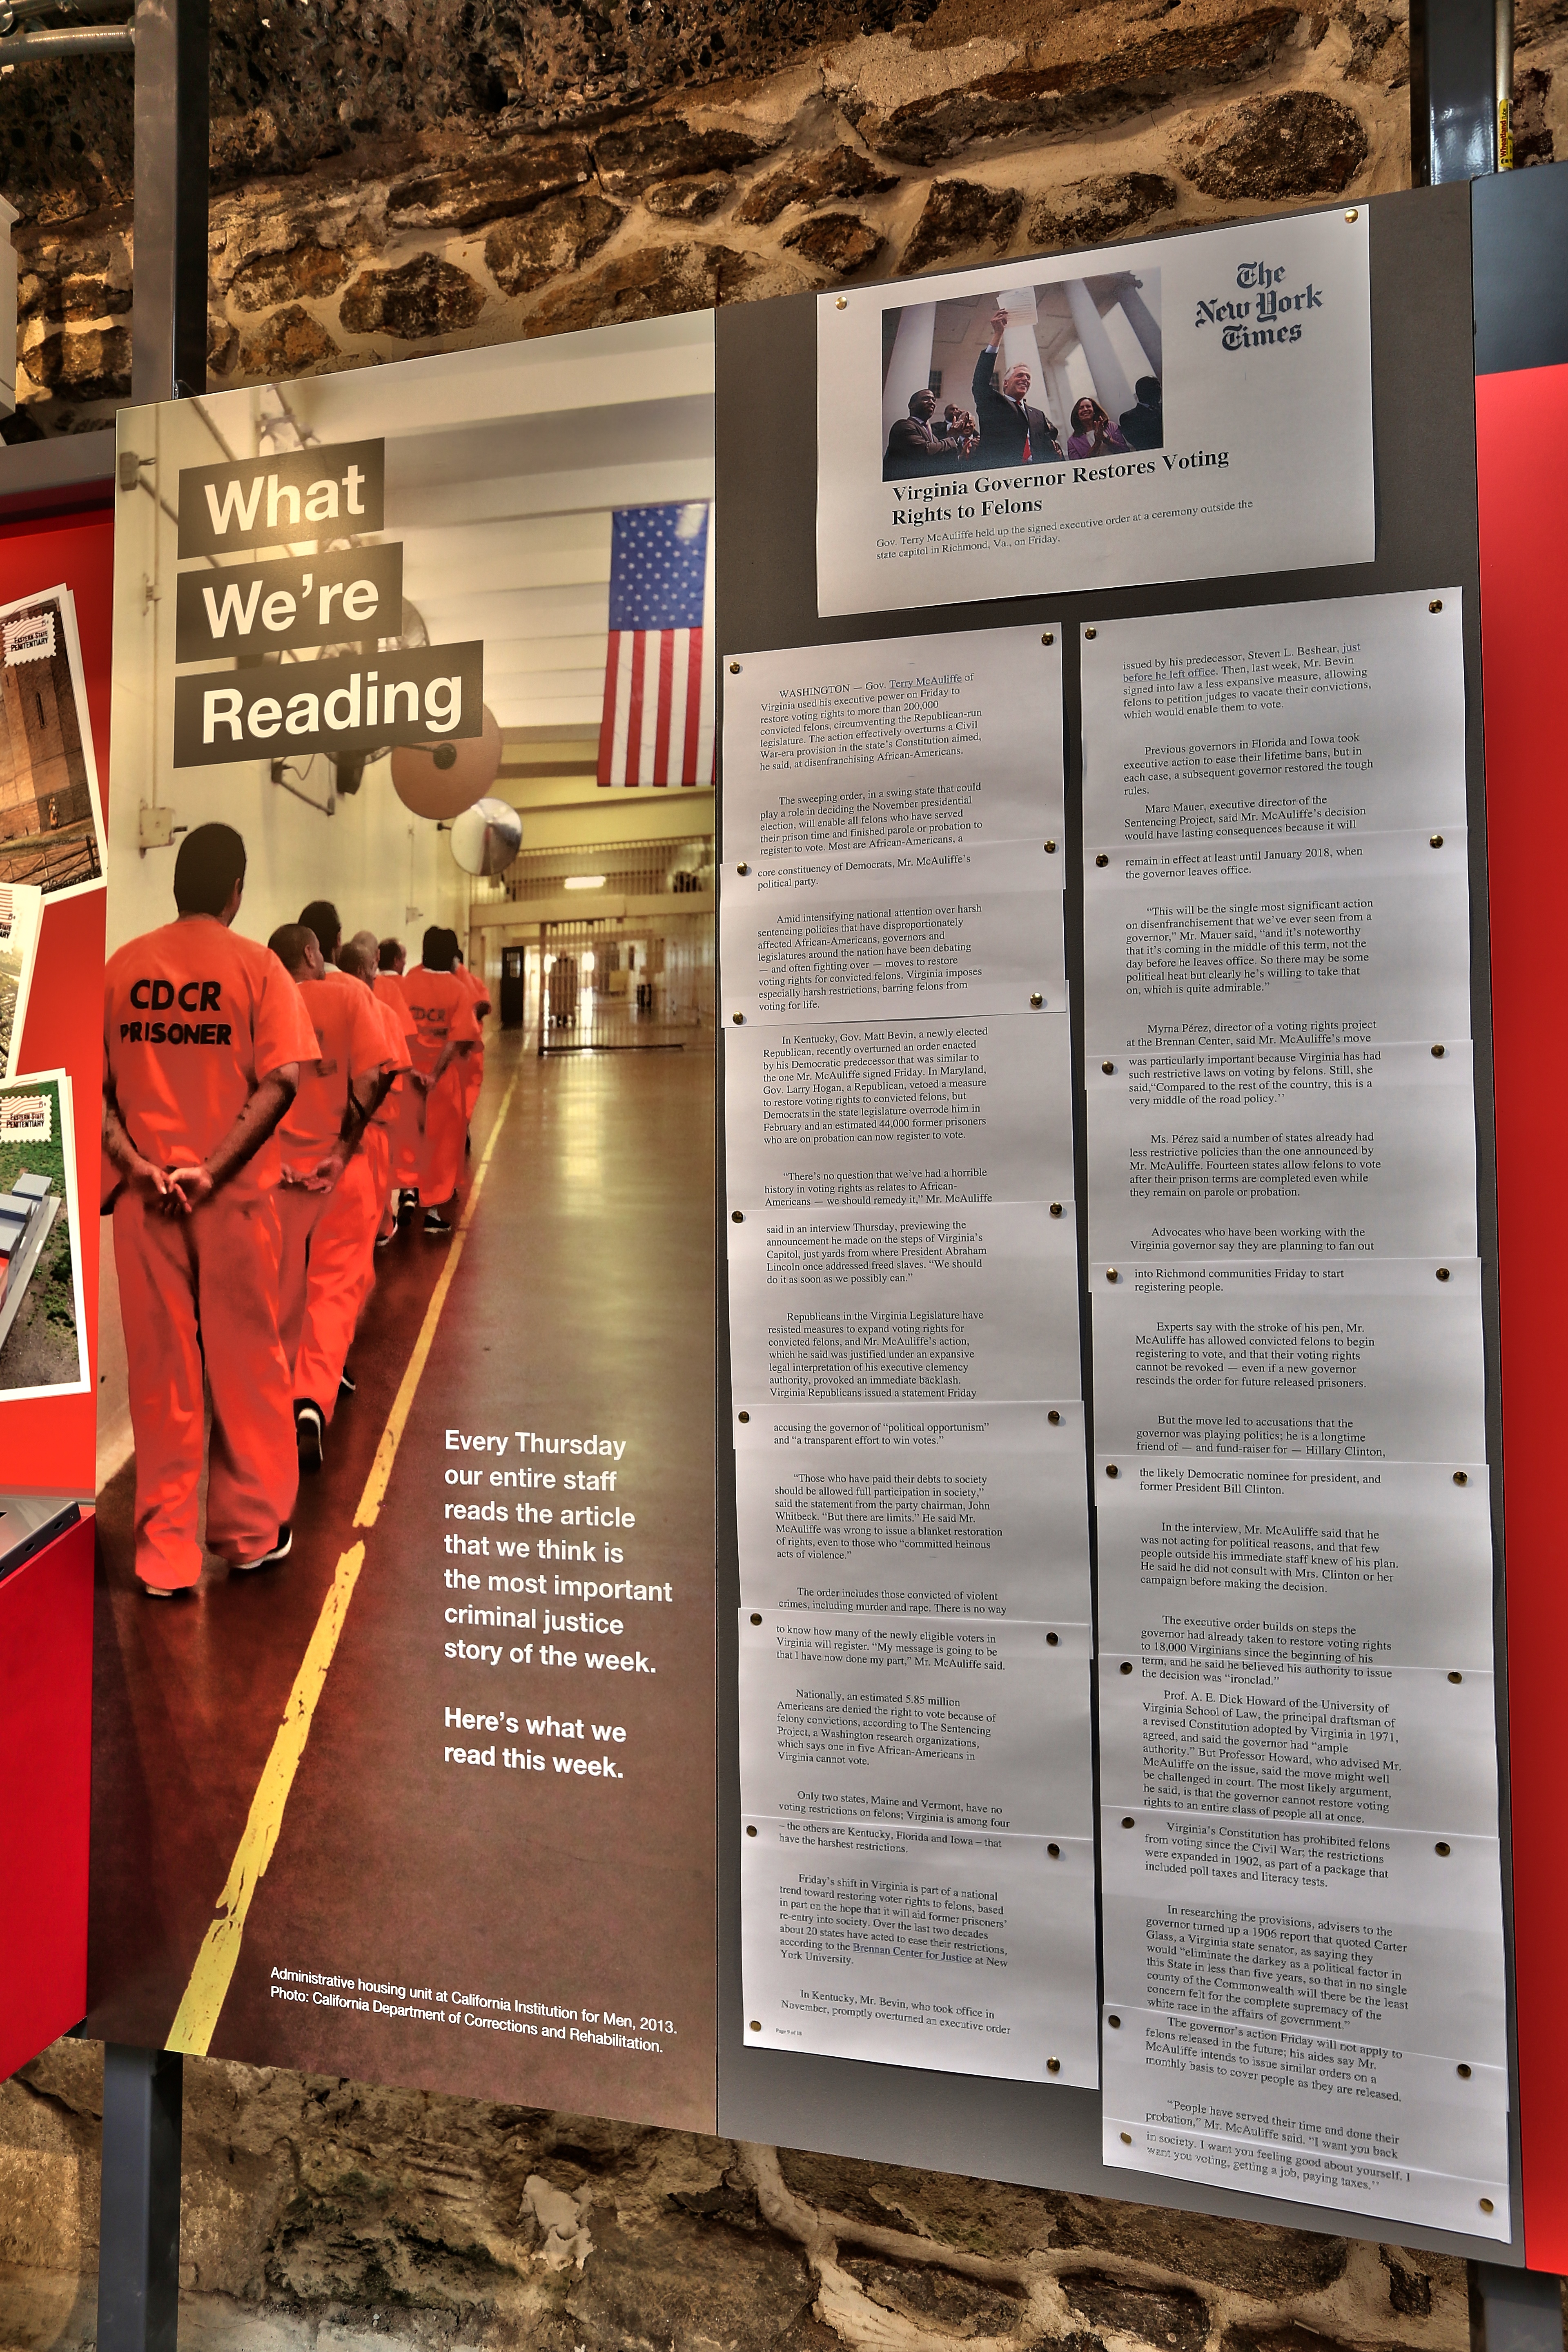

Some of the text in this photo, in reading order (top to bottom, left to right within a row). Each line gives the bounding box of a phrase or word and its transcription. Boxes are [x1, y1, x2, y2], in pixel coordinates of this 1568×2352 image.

[1236, 261, 1286, 289] The
[1195, 283, 1323, 328] New York
[1222, 324, 1302, 351] Times
[892, 450, 1229, 503] Virginia Governor Restores Voting
[204, 464, 365, 536] What
[892, 498, 1042, 527] Rights to Felons
[876, 539, 898, 547] Gov.
[900, 536, 924, 546] Terry
[927, 530, 973, 542] McAuliffe
[976, 528, 995, 538] held
[997, 528, 1009, 537] up
[1011, 526, 1025, 534] the
[1027, 522, 1057, 534] signed
[1059, 519, 1103, 530] executive
[1105, 515, 1131, 525] order
[1133, 513, 1142, 522] at
[1152, 508, 1198, 519] ceremony
[1200, 502, 1236, 513] outside
[1238, 500, 1253, 509] the
[876, 551, 897, 560] state
[898, 546, 928, 559] capitol
[931, 545, 940, 554] in
[942, 540, 991, 553] Richmond,
[993, 539, 1012, 548] Va.,
[1028, 535, 1060, 545] Friday.
[11, 637, 48, 652] PENITENTIARY
[202, 670, 463, 745] Reading
[1145, 733, 1360, 755] Previous governors in Florida and Iowa took
[778, 796, 795, 805] The
[797, 793, 838, 806] sweeping
[840, 791, 865, 801] order,
[868, 790, 876, 799] in
[886, 788, 913, 800] swing
[915, 787, 935, 795] state
[937, 785, 955, 794] that
[956, 782, 982, 792] could
[130, 979, 221, 1012] CDCR
[120, 1021, 232, 1045] PRISONER
[763, 1044, 814, 1059] Republican,
[816, 1043, 851, 1056] recently
[853, 1041, 901, 1054] overturned
[916, 1041, 940, 1051] order
[942, 1039, 977, 1050] enacted
[7, 1119, 45, 1128] PENITENTIARY
[1135, 1349, 1360, 1362] registering to vote, and that their voting rights
[770, 1385, 806, 1399] Virginia
[808, 1385, 862, 1400] Republicans
[864, 1386, 892, 1397] issued
[902, 1389, 946, 1397] statement
[947, 1388, 977, 1400] Friday
[445, 1429, 627, 1460] Every Thursday
[445, 1467, 617, 1491] our entire staff
[445, 1500, 635, 1528] reads the article
[444, 1534, 624, 1563] that we think is
[444, 1568, 672, 1602] the most important
[1140, 1574, 1327, 1592] campaign before making the decision.
[445, 1604, 624, 1634] criminal justice
[444, 1639, 655, 1673] story of the week.
[795, 1689, 844, 1702] Nationally,
[860, 1693, 903, 1703] estimated
[905, 1694, 925, 1704] 5.85
[927, 1696, 960, 1707] million
[526, 1715, 585, 1739] what
[591, 1724, 627, 1743] we
[1150, 1717, 1186, 1728] revised
[1188, 1719, 1250, 1732] Constitution
[1252, 1723, 1292, 1737] adopted
[1294, 1726, 1307, 1738] by
[1310, 1727, 1353, 1740] Virginia
[1356, 1730, 1366, 1740] in
[1370, 1731, 1399, 1743] 1971,
[445, 1746, 623, 1778] read this week.
[1145, 1861, 1327, 1887] included poll taxes and literacy tests.
[270, 1966, 677, 2034] Administrative housing unit at California Institution for Men, 2013.
[271, 1985, 663, 2053] Photo: California Department of Corrections and Rehabilitation.
[1147, 2147, 1171, 2158] want
[1173, 2152, 1192, 2161] you
[1195, 2155, 1230, 2169] voting,
[1233, 2161, 1268, 2176] getting
[1303, 2172, 1338, 2187] paying
